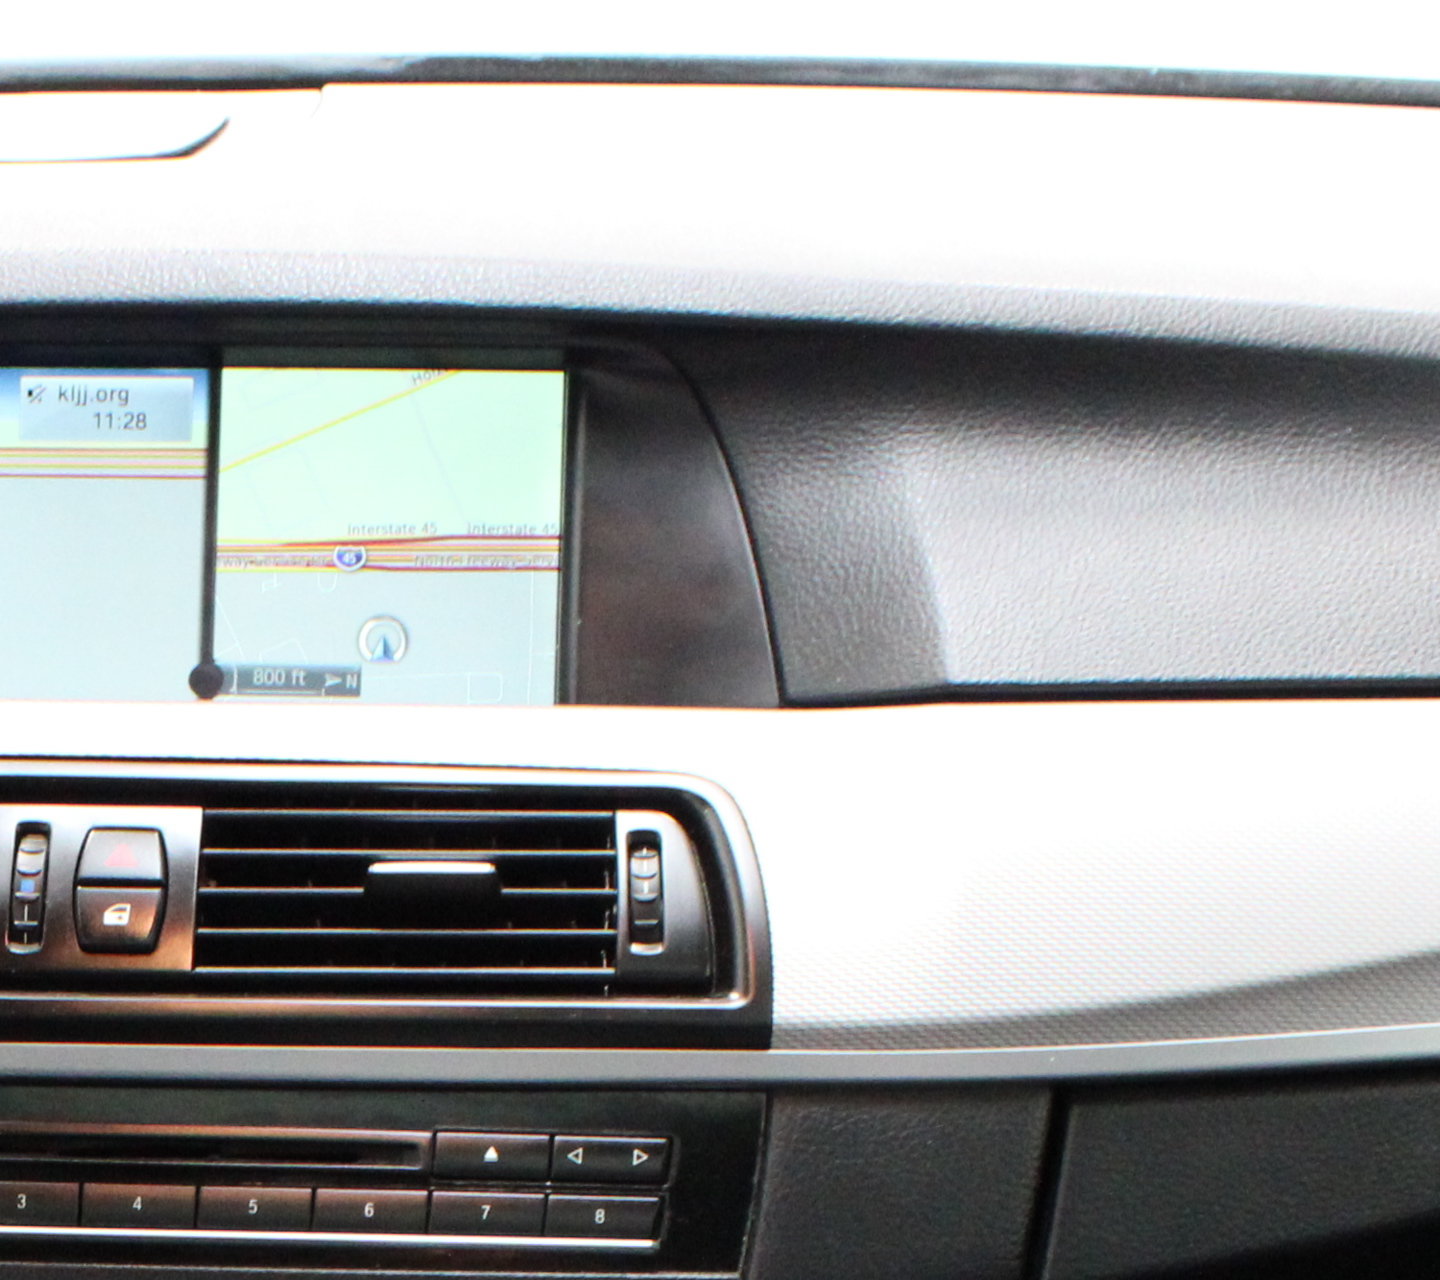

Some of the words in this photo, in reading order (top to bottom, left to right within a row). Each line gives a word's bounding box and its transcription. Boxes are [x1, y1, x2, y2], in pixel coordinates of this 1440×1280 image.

[92, 412, 147, 431] 11:28
[348, 524, 417, 536] Interstate
[422, 524, 438, 536] 45
[253, 669, 286, 685] 800
[291, 668, 306, 686] ft
[17, 1193, 27, 1210] 3
[132, 1196, 142, 1212] 4
[248, 1199, 258, 1215] 5
[364, 1202, 374, 1218] 6
[481, 1205, 491, 1221] 7
[595, 1208, 605, 1224] 8
